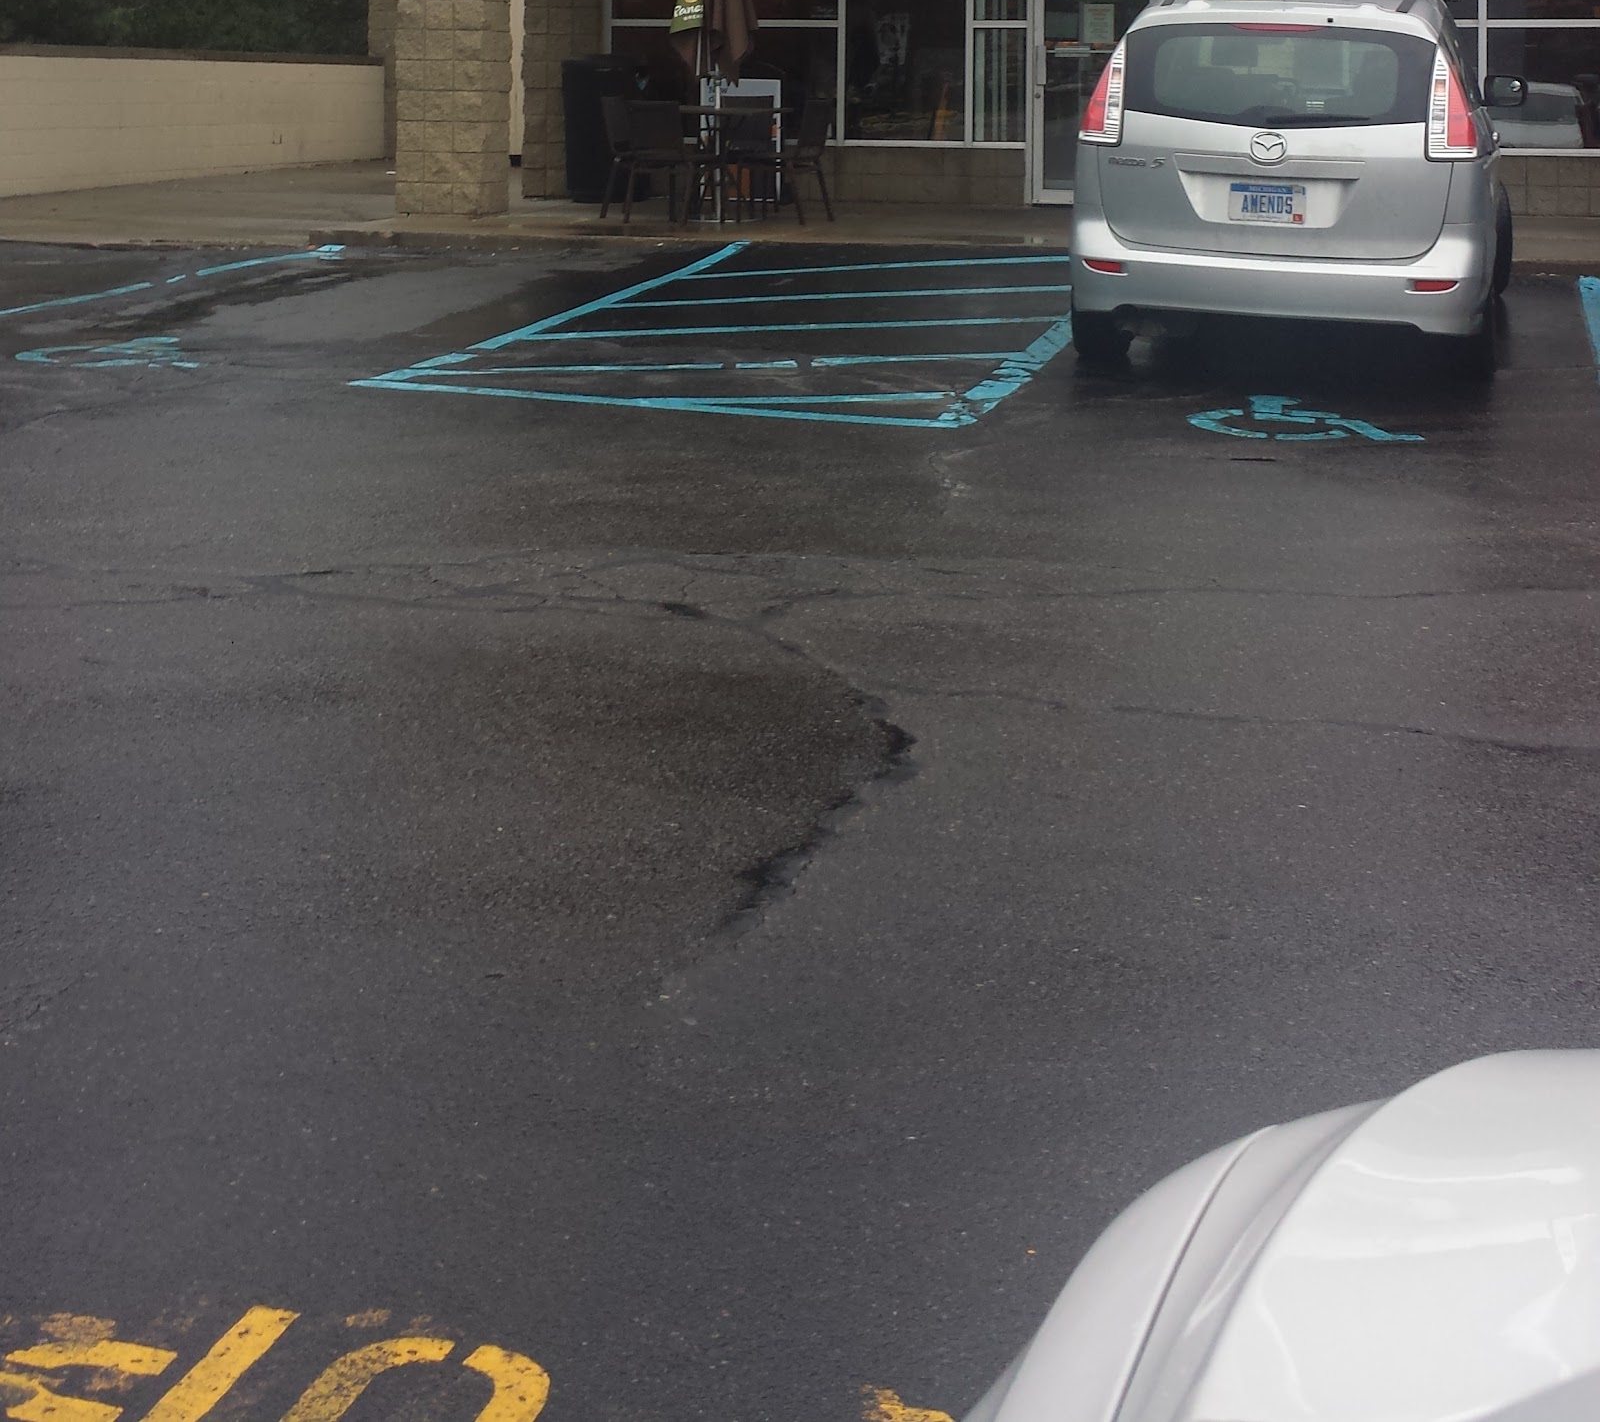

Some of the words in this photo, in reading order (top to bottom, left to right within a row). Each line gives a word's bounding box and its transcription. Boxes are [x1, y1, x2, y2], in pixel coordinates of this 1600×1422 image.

[1150, 156, 1167, 169] 5
[1249, 185, 1288, 193] MICHIGAN
[1241, 194, 1293, 214] AMENDS
